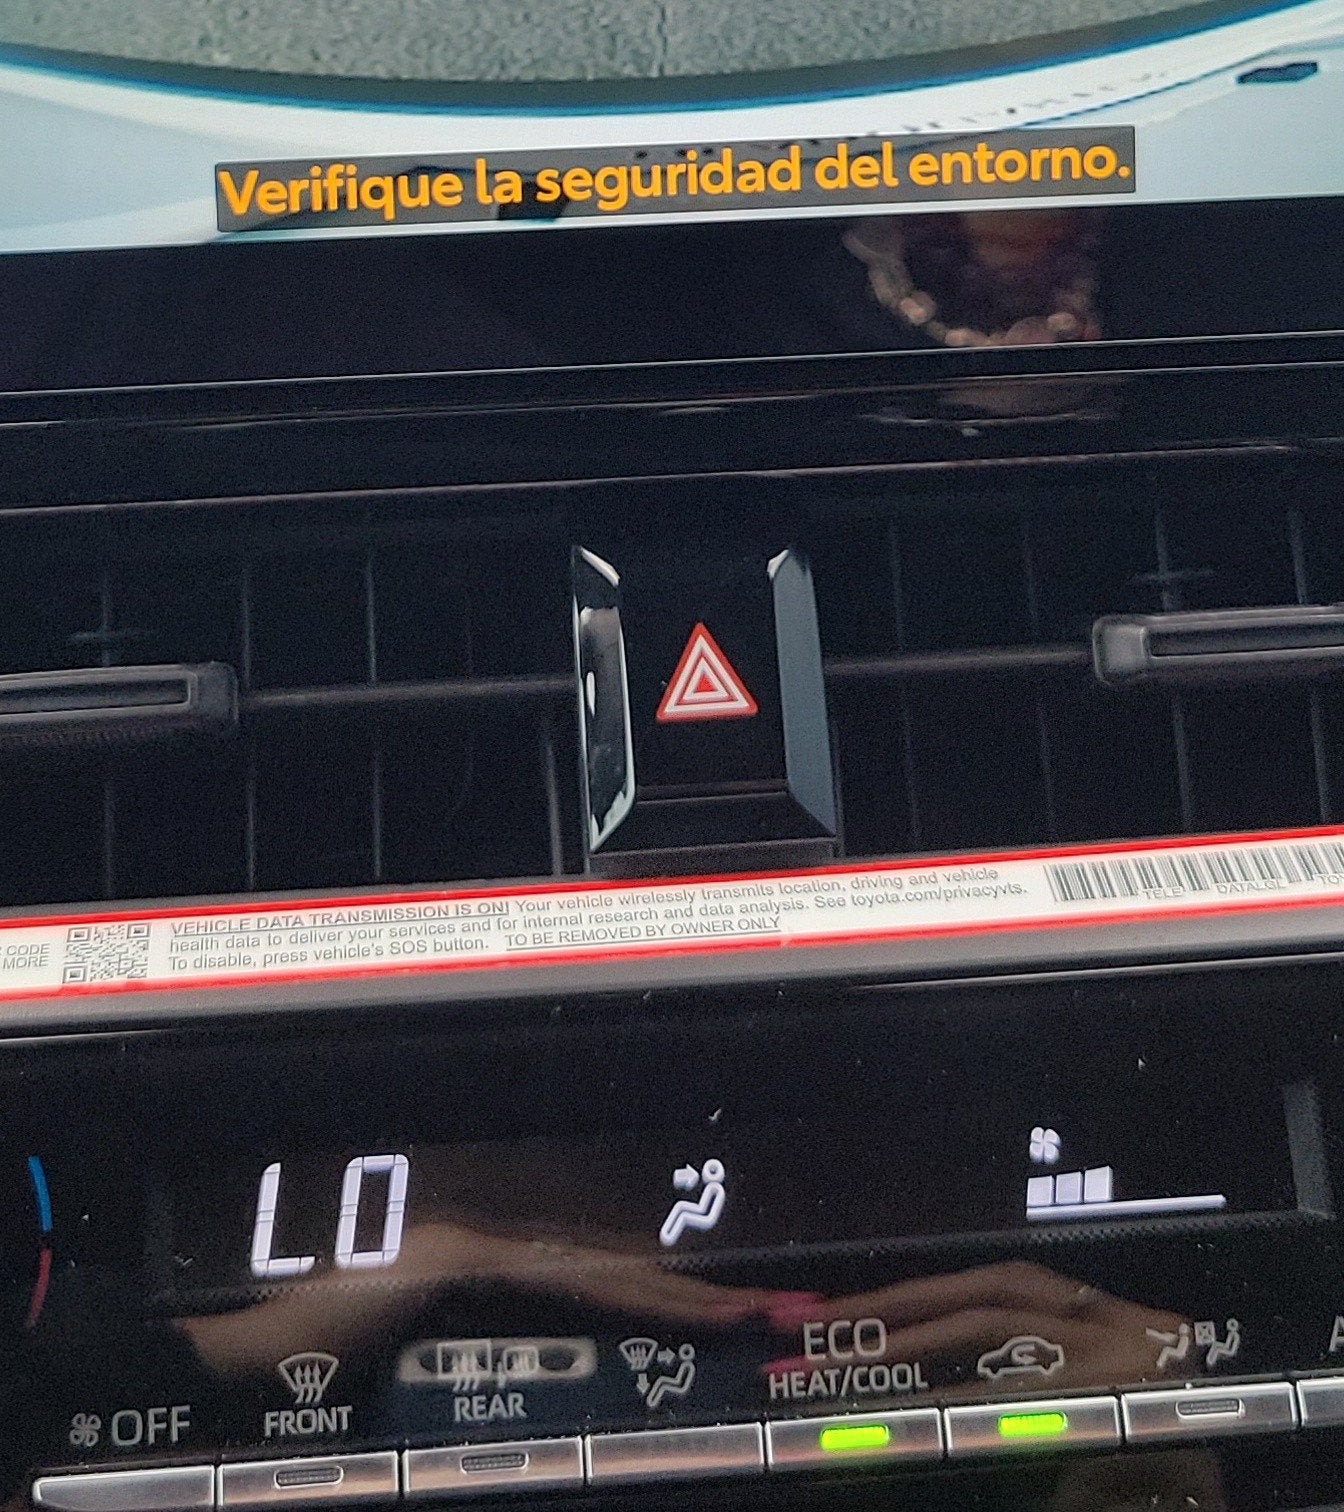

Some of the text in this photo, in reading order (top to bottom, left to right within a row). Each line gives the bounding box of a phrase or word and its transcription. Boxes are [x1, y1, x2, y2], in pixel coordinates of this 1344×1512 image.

[217, 140, 1131, 221] Verifique la seguridad del entorno.
[170, 919, 251, 935] VEHICLE
[256, 915, 304, 930] DATA
[309, 904, 450, 926] TRANSMISSION
[455, 902, 473, 917] IS
[515, 897, 552, 913] Your
[556, 893, 613, 910] vehicle
[618, 884, 696, 906] wirelessly
[701, 881, 775, 901] transmits
[850, 873, 903, 892] driving
[908, 870, 939, 886] and
[943, 866, 1000, 884] vehicle
[168, 915, 780, 971] To disable, press vehicle's SOS button. TO BE REMOVED BY OWNER ONLY
[169, 934, 219, 954] health
[225, 934, 261, 950] data
[268, 932, 283, 947] to
[289, 928, 343, 946] deliver
[348, 926, 384, 944] your
[389, 919, 456, 940] services
[461, 916, 492, 933] and
[496, 914, 519, 931] for
[522, 911, 584, 929] internal
[588, 906, 659, 925] research
[664, 904, 694, 920] and
[699, 901, 735, 918] data
[739, 896, 809, 916] analysis.
[814, 894, 847, 909] See
[2, 954, 50, 970] MORE
[6, 942, 51, 957] CODE
[803, 1317, 888, 1363] ECO
[768, 1361, 929, 1400] HEAT/COOL
[111, 1404, 193, 1448] OFF
[264, 1404, 353, 1438] FRONT
[454, 1392, 527, 1423] REAR
